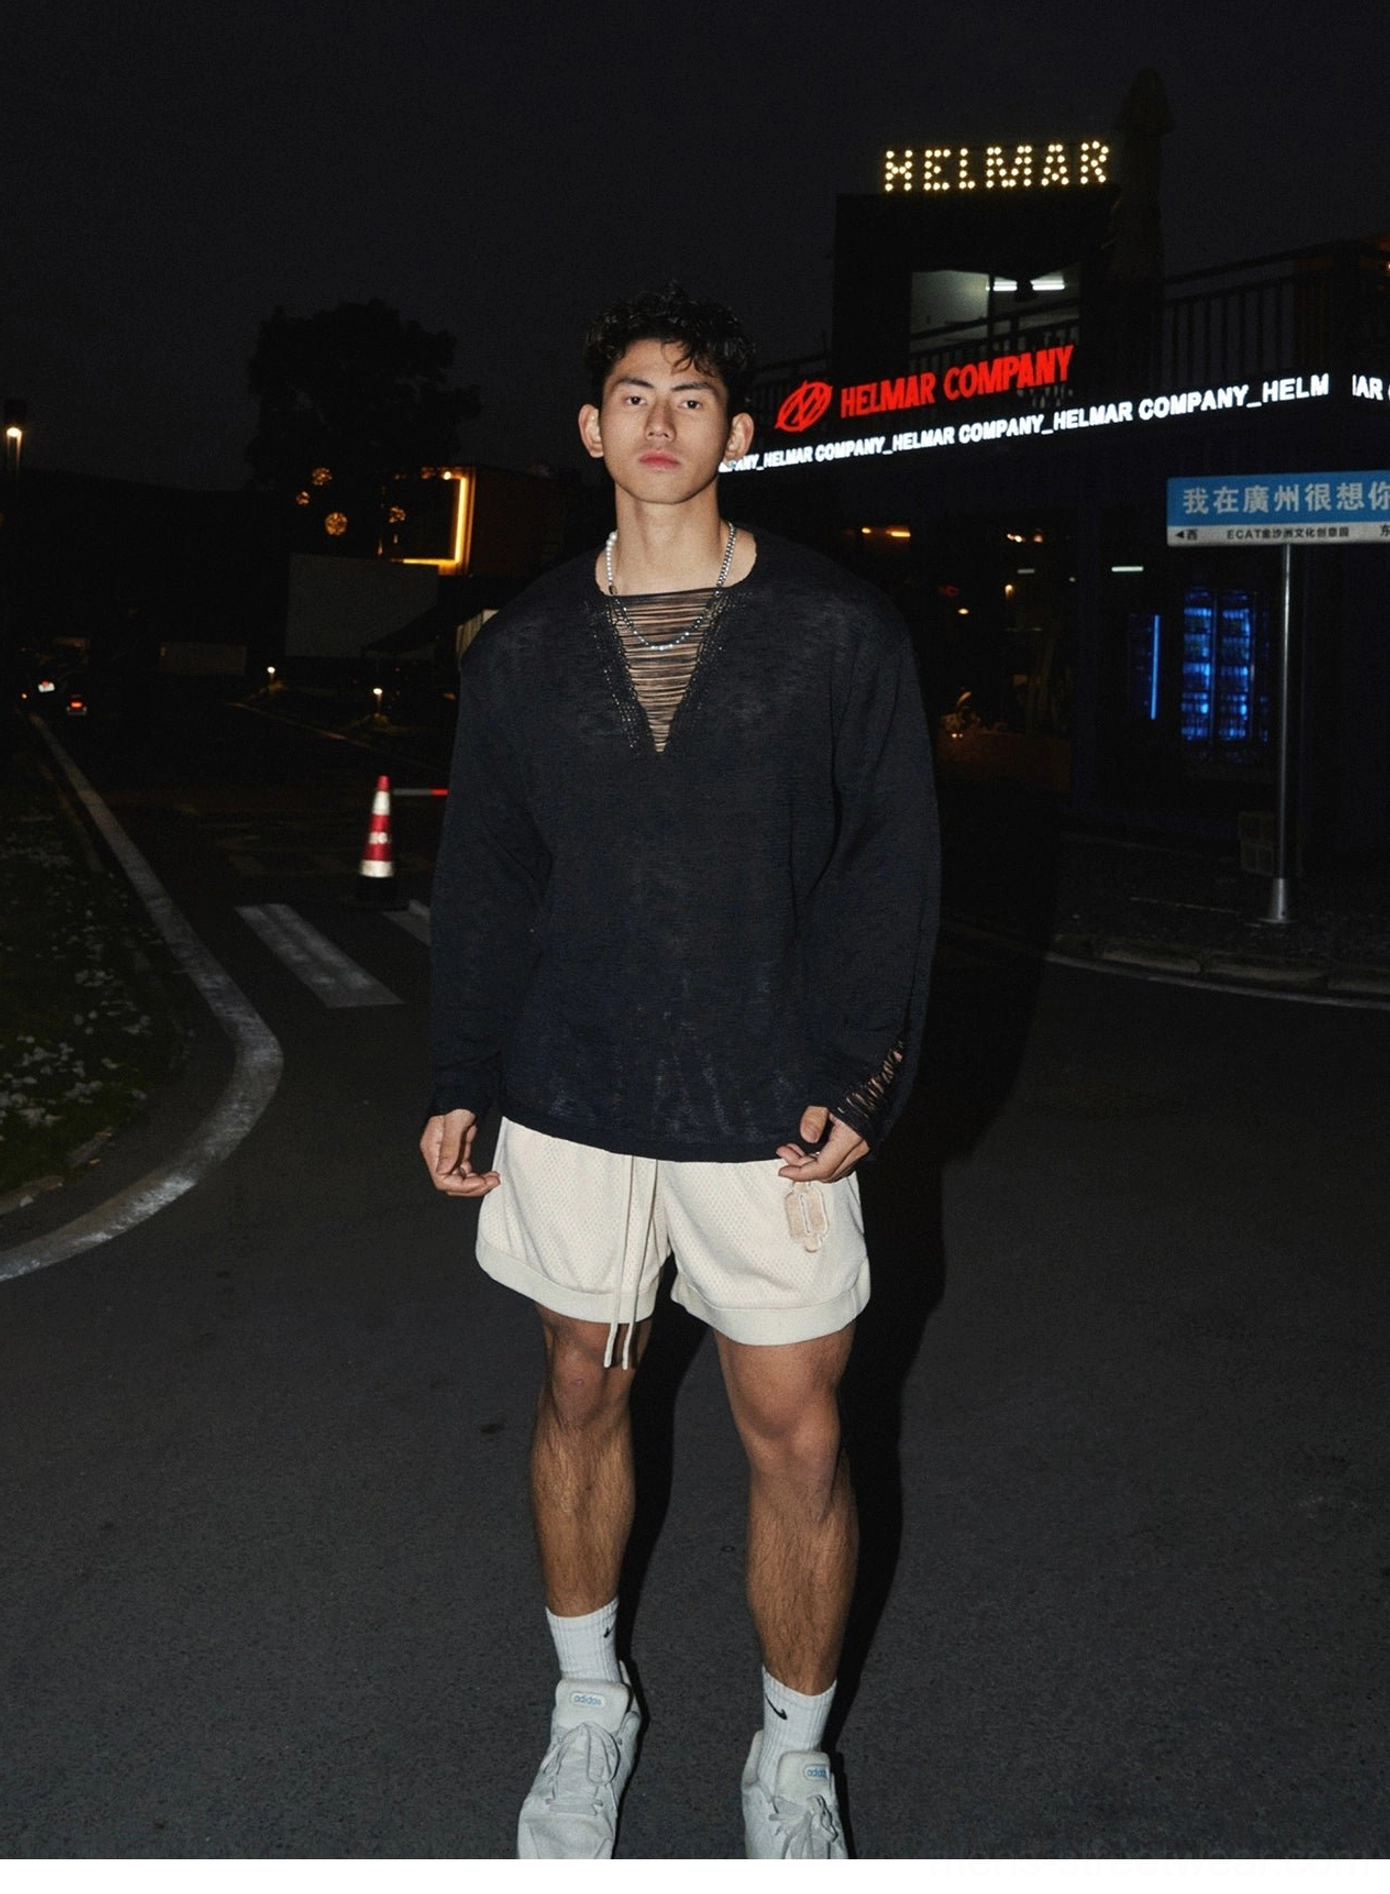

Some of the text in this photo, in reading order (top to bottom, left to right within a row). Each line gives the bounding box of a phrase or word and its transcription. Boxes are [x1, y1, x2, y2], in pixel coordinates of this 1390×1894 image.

[885, 140, 1109, 192] HELMAR
[840, 345, 1074, 419] HELMAR COMPANY
[1182, 480, 1390, 515] 我在廣州很想你
[1186, 528, 1198, 541] 西
